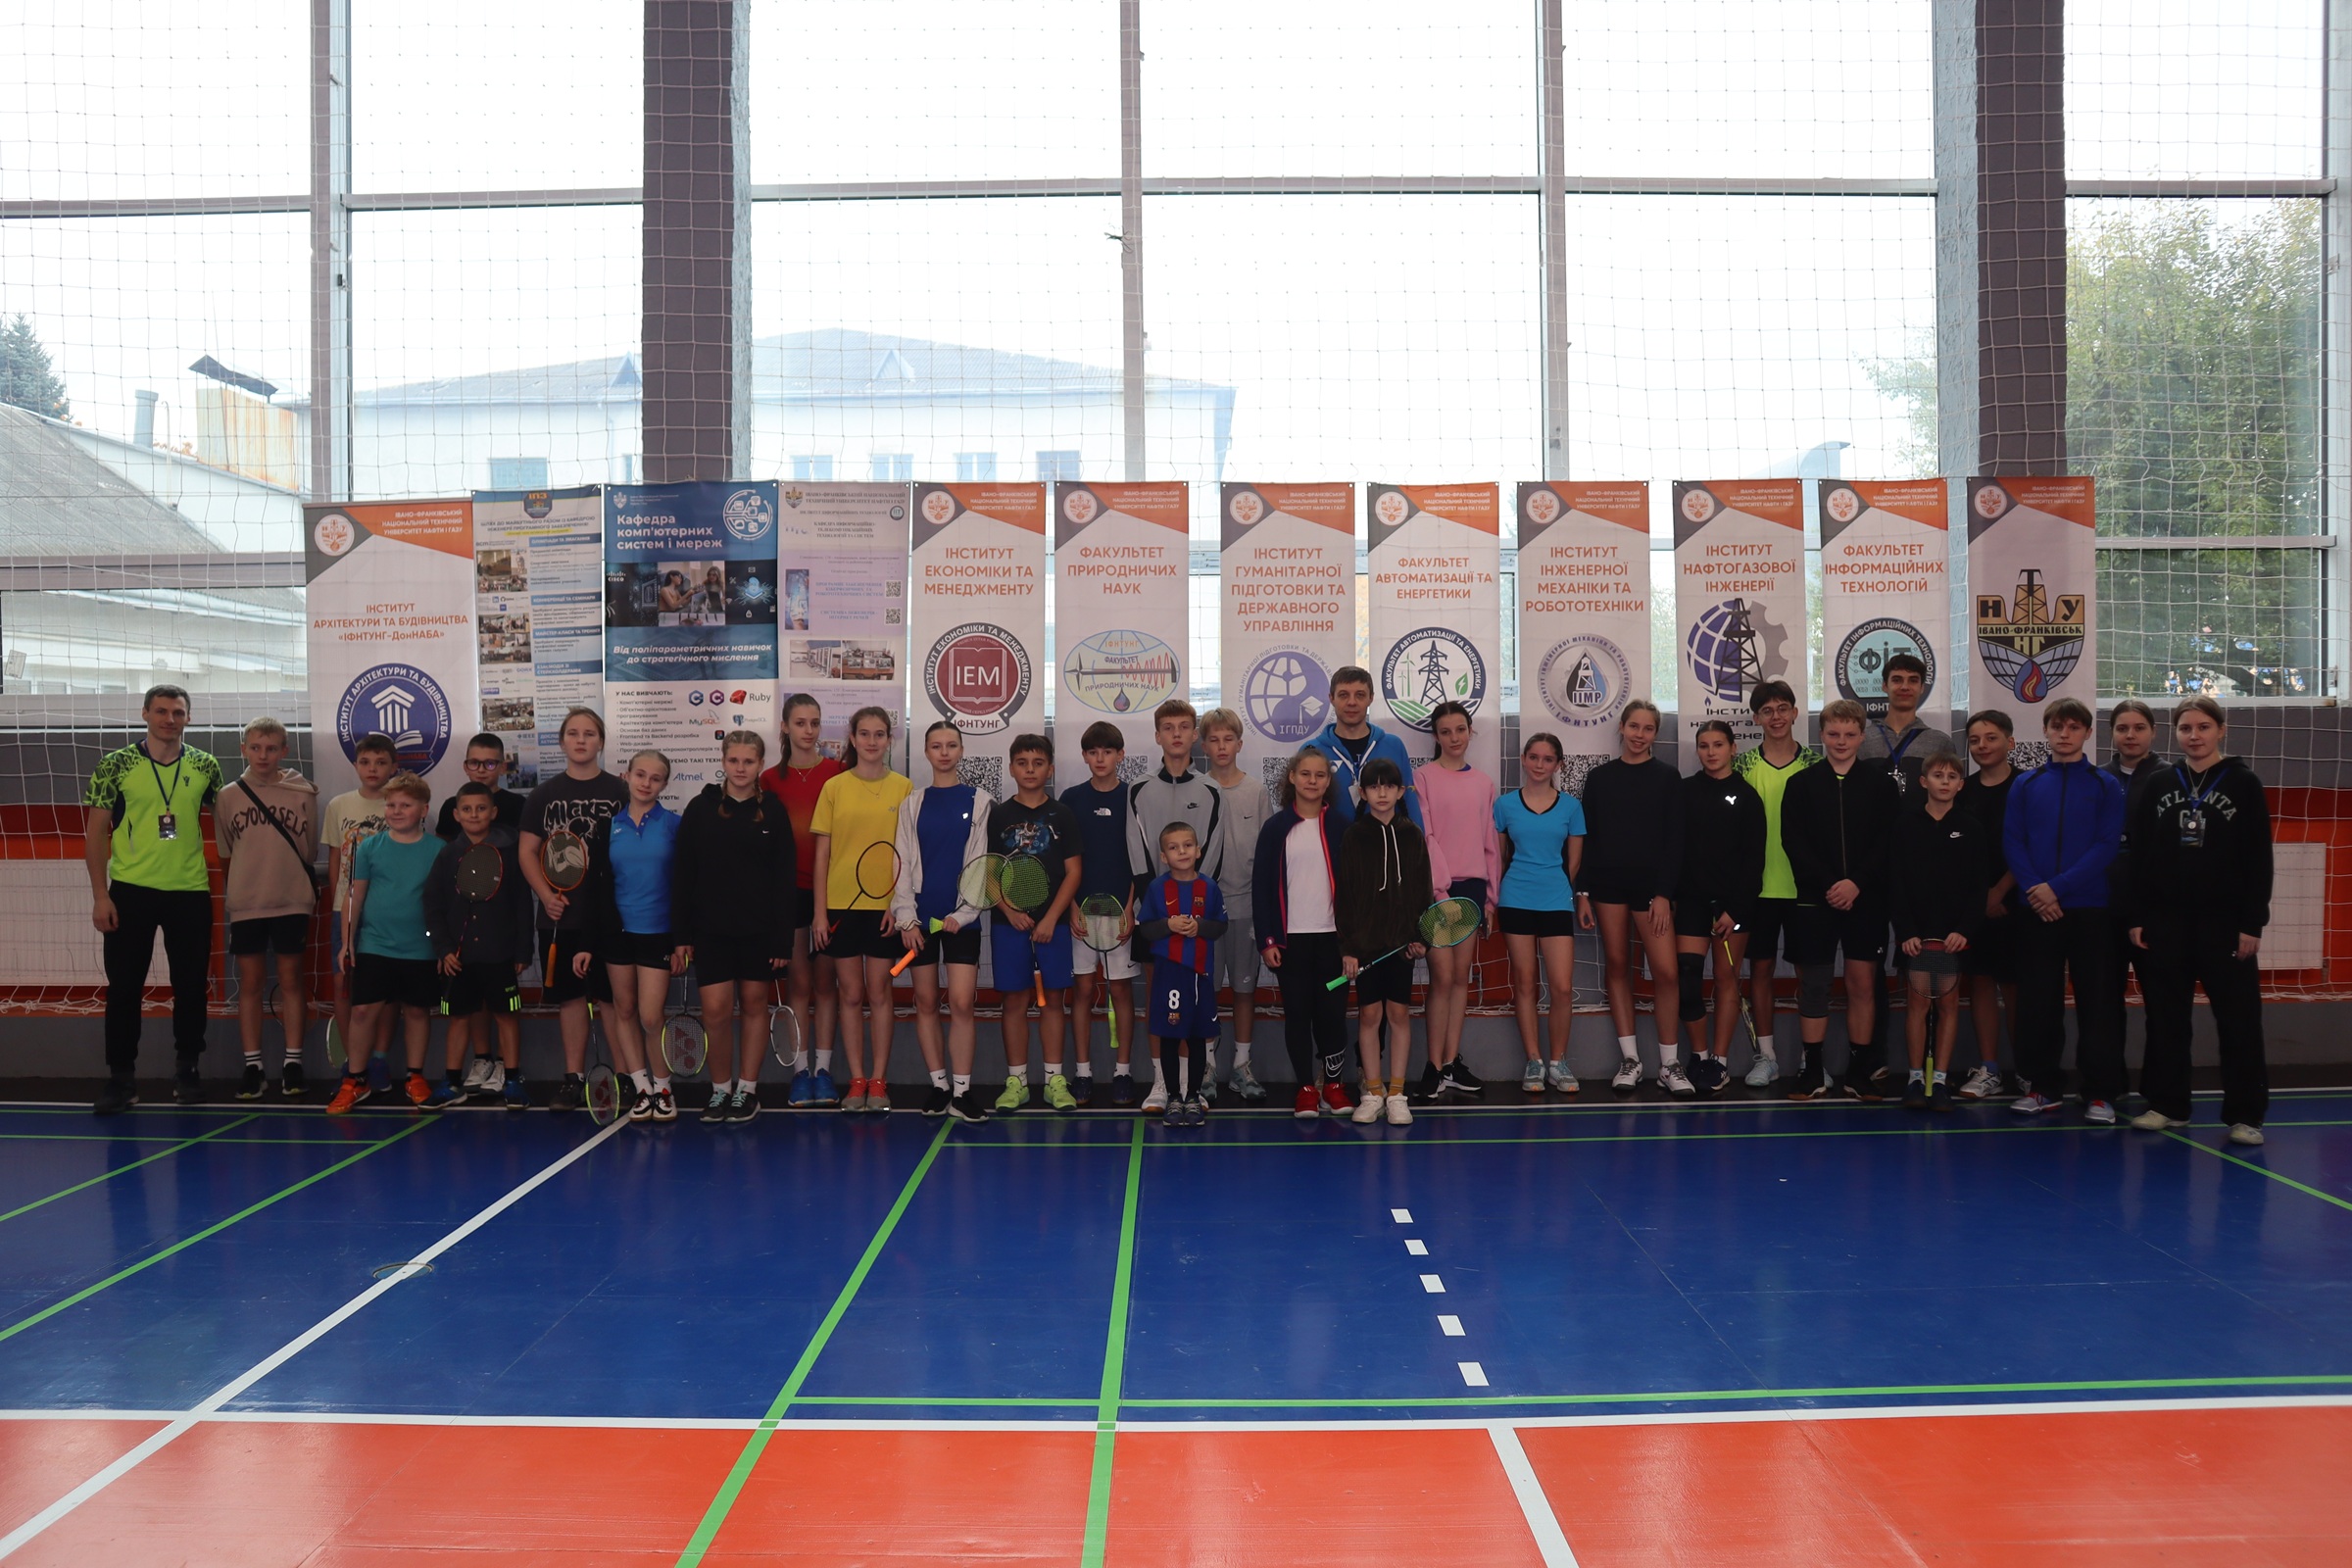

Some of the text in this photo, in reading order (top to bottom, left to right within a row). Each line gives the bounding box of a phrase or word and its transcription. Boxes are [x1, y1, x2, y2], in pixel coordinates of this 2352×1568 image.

[395, 510, 463, 518] ІВАНО-ФРАНКІВСЬКИЙ
[616, 514, 675, 526] Кафедра
[616, 527, 713, 538] комп'ютерних
[616, 538, 723, 550] систем і мереж
[946, 548, 1014, 559] ІНСТИТУТ
[1080, 547, 1164, 558] ФАКУЛЬТЕТ
[1254, 548, 1323, 560] ІНСТИТУТ
[1550, 547, 1618, 558] ІНСТИТУТ
[1706, 544, 1773, 557] ІНСТИТУТ
[1843, 544, 1924, 557] ФАКУЛЬТЕТ
[1397, 558, 1469, 567] ФАКУЛЬТЕТ
[1684, 559, 1796, 574] НАФТОГАЗОВОЇ
[1825, 560, 1943, 576] ІНФОРМАЦІЙНИХ
[925, 565, 1034, 577] ЕКОНОМІКИ ТА
[1067, 564, 1177, 577] ПРИРОДНИЧИХ
[1236, 563, 1343, 577] ГУМАНІТАРНОЇ
[1541, 562, 1629, 576] ІНЖЕНЕРНОЇ
[1376, 570, 1493, 584] АВТОМАТИЗАЦІЇ ТА
[924, 583, 1034, 597] МЕНЕДЖМЕНТУ
[1103, 583, 1141, 594] НАУК
[1231, 584, 1346, 597] ПІДГОТОВКИ ТА
[1538, 582, 1632, 594] МЕХАНІКИ ТА
[1705, 577, 1775, 592] ІНЖЕНЕРІЇ
[1840, 578, 1928, 593] ТЕХНОЛОГІЙ
[1397, 589, 1471, 599] ЕНЕРГЕТИКИ
[366, 603, 415, 613] ІНСТИТУТ
[1237, 602, 1339, 615] ДЕРЖАВНОГО
[1526, 600, 1643, 612] РОБОТОТЕХНІКИ
[1980, 600, 2001, 617] Н
[2061, 600, 2081, 621] У
[314, 614, 468, 629] АРХІТЕКТУРИ ТА БУДІВНИЦТВА
[1244, 620, 1334, 632] УПРАВЛІННЯ
[1979, 624, 2082, 635] ІВАНО-ФРАНКІВСЬК
[632, 645, 729, 655] поліпараметричних
[1838, 620, 1934, 686] ФАКУЛЬТЕТ ІНФОРМАЦІЙНИХ ТЕХНОЛОГІЙ
[642, 654, 709, 663] стратегічного
[926, 625, 1030, 696] ІНСТИТУТ ЕКОНОМІКИ ТА МЕНЕДЖМЕНТУ
[1386, 630, 1481, 689] ФАКУЛЬТЕТ АВТОМАТИЗАЦІЇ ТА ЕНЕРГЕТИКИ
[956, 666, 1000, 686] ІЕМ
[1085, 682, 1139, 692] ПРИРОДНИЧИХ
[1240, 706, 1257, 735] ІНСТИТУТ
[1259, 645, 1299, 658] ПІДГОТОВКИ
[750, 693, 771, 703] Ruby
[340, 666, 449, 743] ІНСТИТУТ АРХІТЕКТУРИ ТА БУДІВНИЦТВА
[1866, 703, 1889, 711] ІФНТ
[954, 719, 1000, 728] ІФНТУНГ
[1280, 725, 1309, 735] ІГПДУ
[673, 772, 704, 781] Atmel
[1168, 989, 1181, 1009] 8
